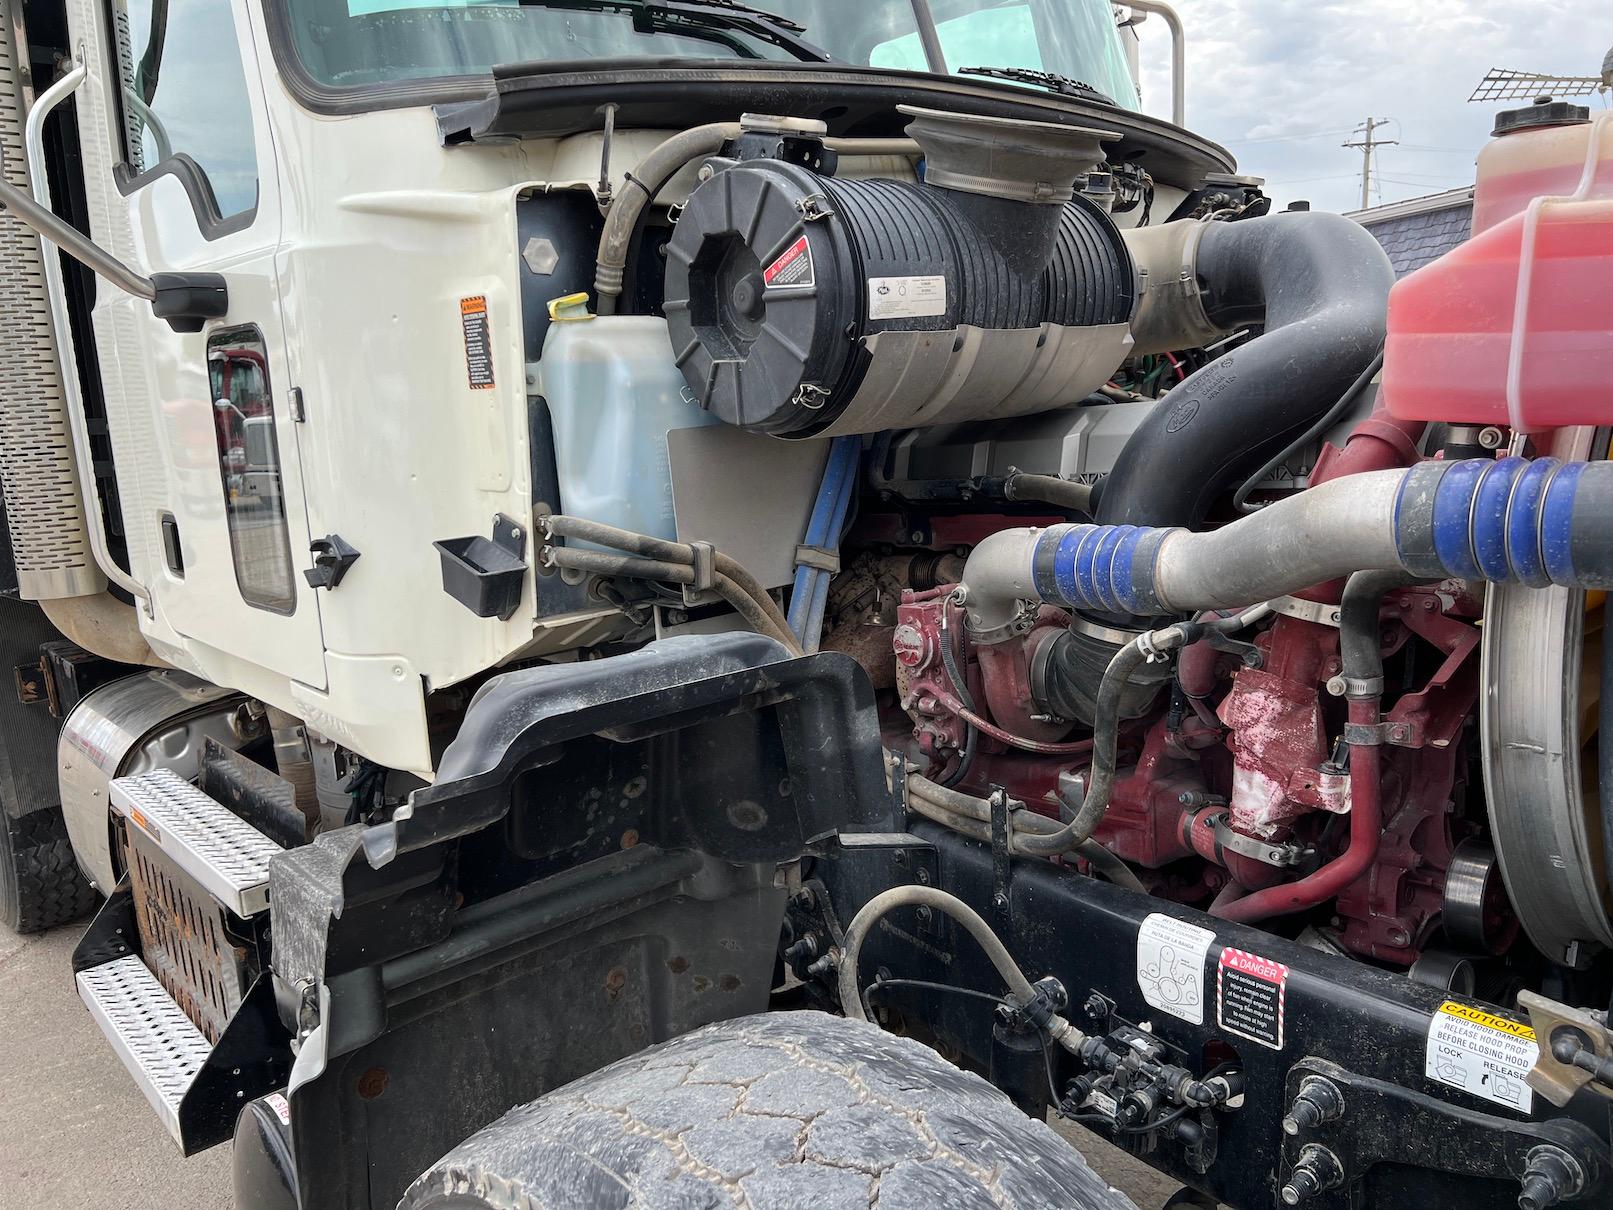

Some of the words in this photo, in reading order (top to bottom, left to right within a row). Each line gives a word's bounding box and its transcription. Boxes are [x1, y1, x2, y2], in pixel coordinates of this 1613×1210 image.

[1239, 958, 1277, 979] DANGER
[1227, 971, 1239, 981] Avoid
[1239, 976, 1256, 987] serious
[1255, 982, 1276, 993] personal
[1232, 992, 1240, 1000] fan
[1240, 995, 1253, 1004] when
[1253, 1000, 1269, 1010] engine
[1225, 1017, 1240, 1027] speed
[1239, 1022, 1256, 1033] without
[1238, 1013, 1252, 1022] rotate
[1256, 1020, 1268, 1029] high
[1253, 1009, 1264, 1018] may
[1263, 1013, 1274, 1021] start
[1445, 1004, 1520, 1033] CAUTION
[1445, 1015, 1470, 1027] AVOID
[1471, 1023, 1494, 1035] HOOD
[1443, 1023, 1479, 1040] RELEASE
[1480, 1034, 1504, 1048] HOOD
[1505, 1042, 1528, 1055] PROP
[1437, 1032, 1467, 1048] BEFORE
[1468, 1041, 1503, 1060] CLOSING
[1505, 1054, 1529, 1068] HOOD
[1438, 1045, 1463, 1059] LOCK
[1483, 1060, 1526, 1081] RELEASE
